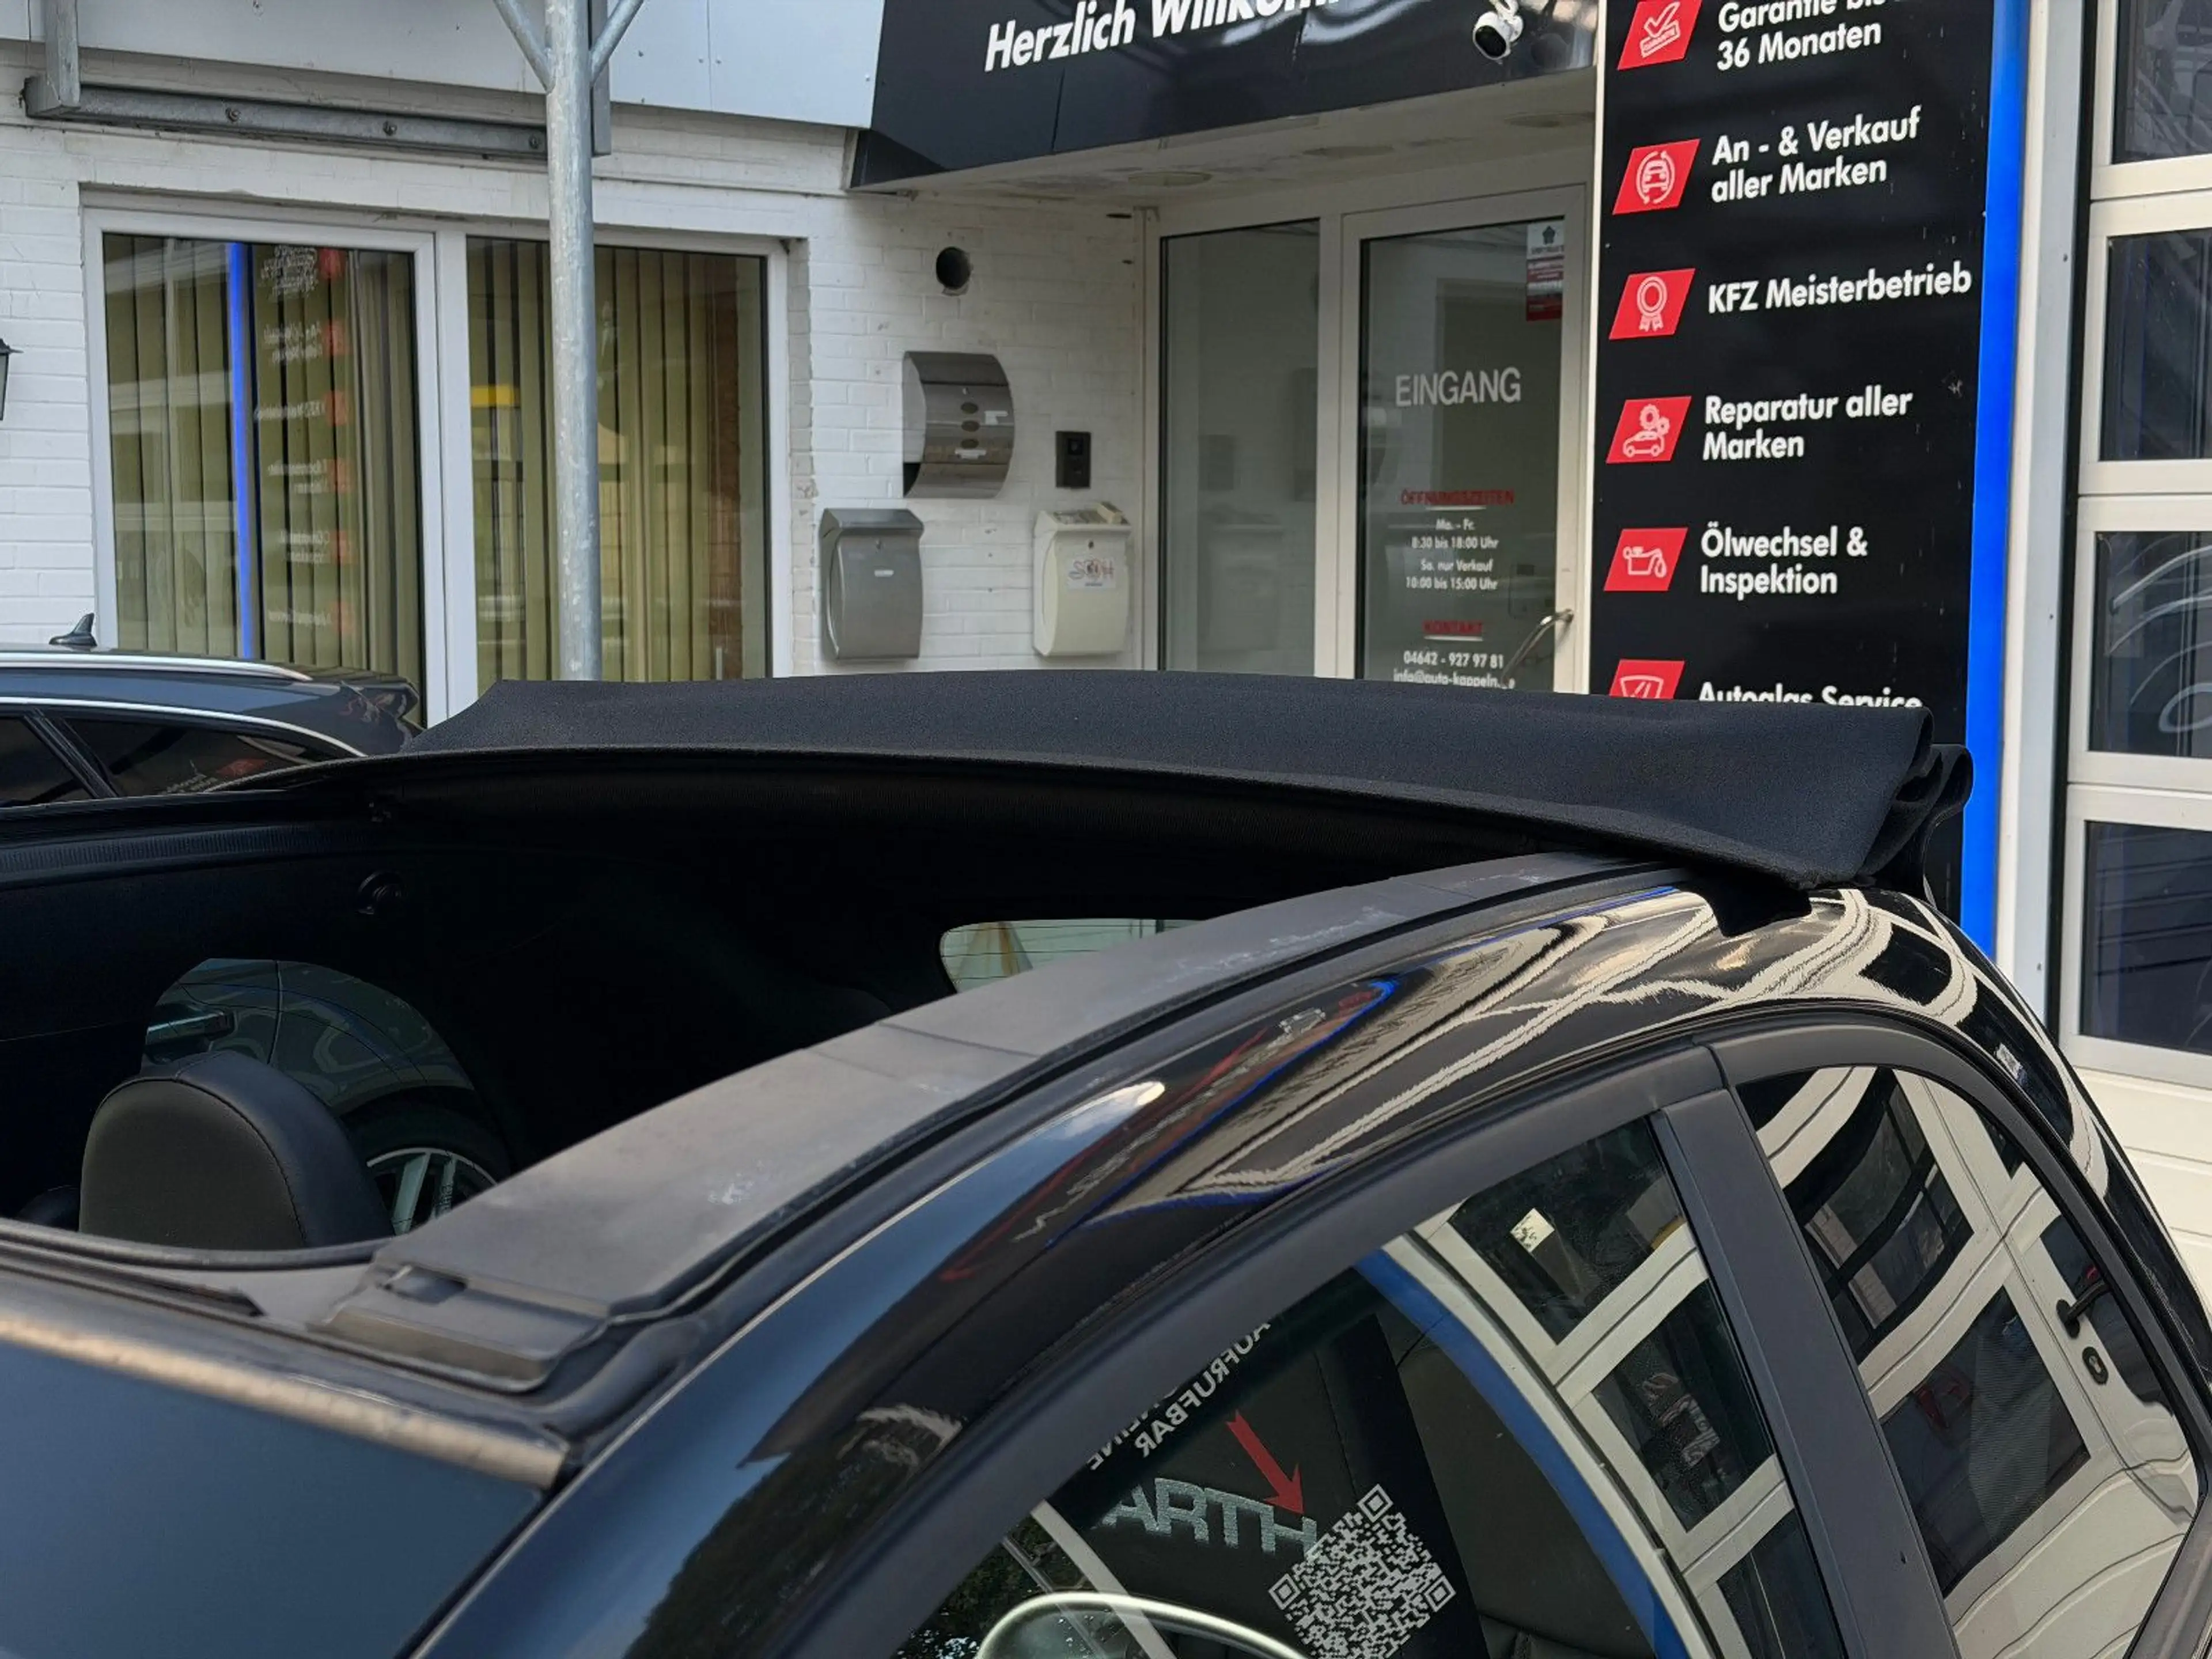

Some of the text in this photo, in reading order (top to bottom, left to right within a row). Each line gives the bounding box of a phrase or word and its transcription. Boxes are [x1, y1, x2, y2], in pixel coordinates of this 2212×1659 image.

[1718, 0, 1836, 32] Garantie
[985, 0, 1135, 71] Herzlich
[1717, 37, 1749, 71] 36
[1758, 22, 1880, 63] Monaten
[1711, 136, 1749, 166] An
[1778, 126, 1798, 156] &
[1807, 106, 1921, 153] Verkauf
[1711, 156, 1887, 202] aller Marken
[1709, 262, 1971, 314] KFZ Meisterbetrieb
[1396, 367, 1521, 407] EINGANG
[1705, 386, 1913, 430] Reparatur aller
[1702, 429, 1804, 461] Marken
[1434, 536, 1448, 549] bis
[1451, 536, 1478, 549] 18:00
[1480, 536, 1499, 549] Uhr
[1701, 521, 1868, 558] Ölwechsel &
[1406, 576, 1498, 590] 10:00 bis 15:00 Uhr
[1438, 562, 1453, 571] nur
[1456, 558, 1493, 571] Verkauf
[1701, 563, 1838, 600] Inspektion
[1403, 650, 1437, 666] 04642
[1449, 651, 1469, 667] 927
[1472, 652, 1487, 668] 97
[1490, 653, 1503, 669] 81
[1393, 668, 1516, 689] info@auto-kappeln.e
